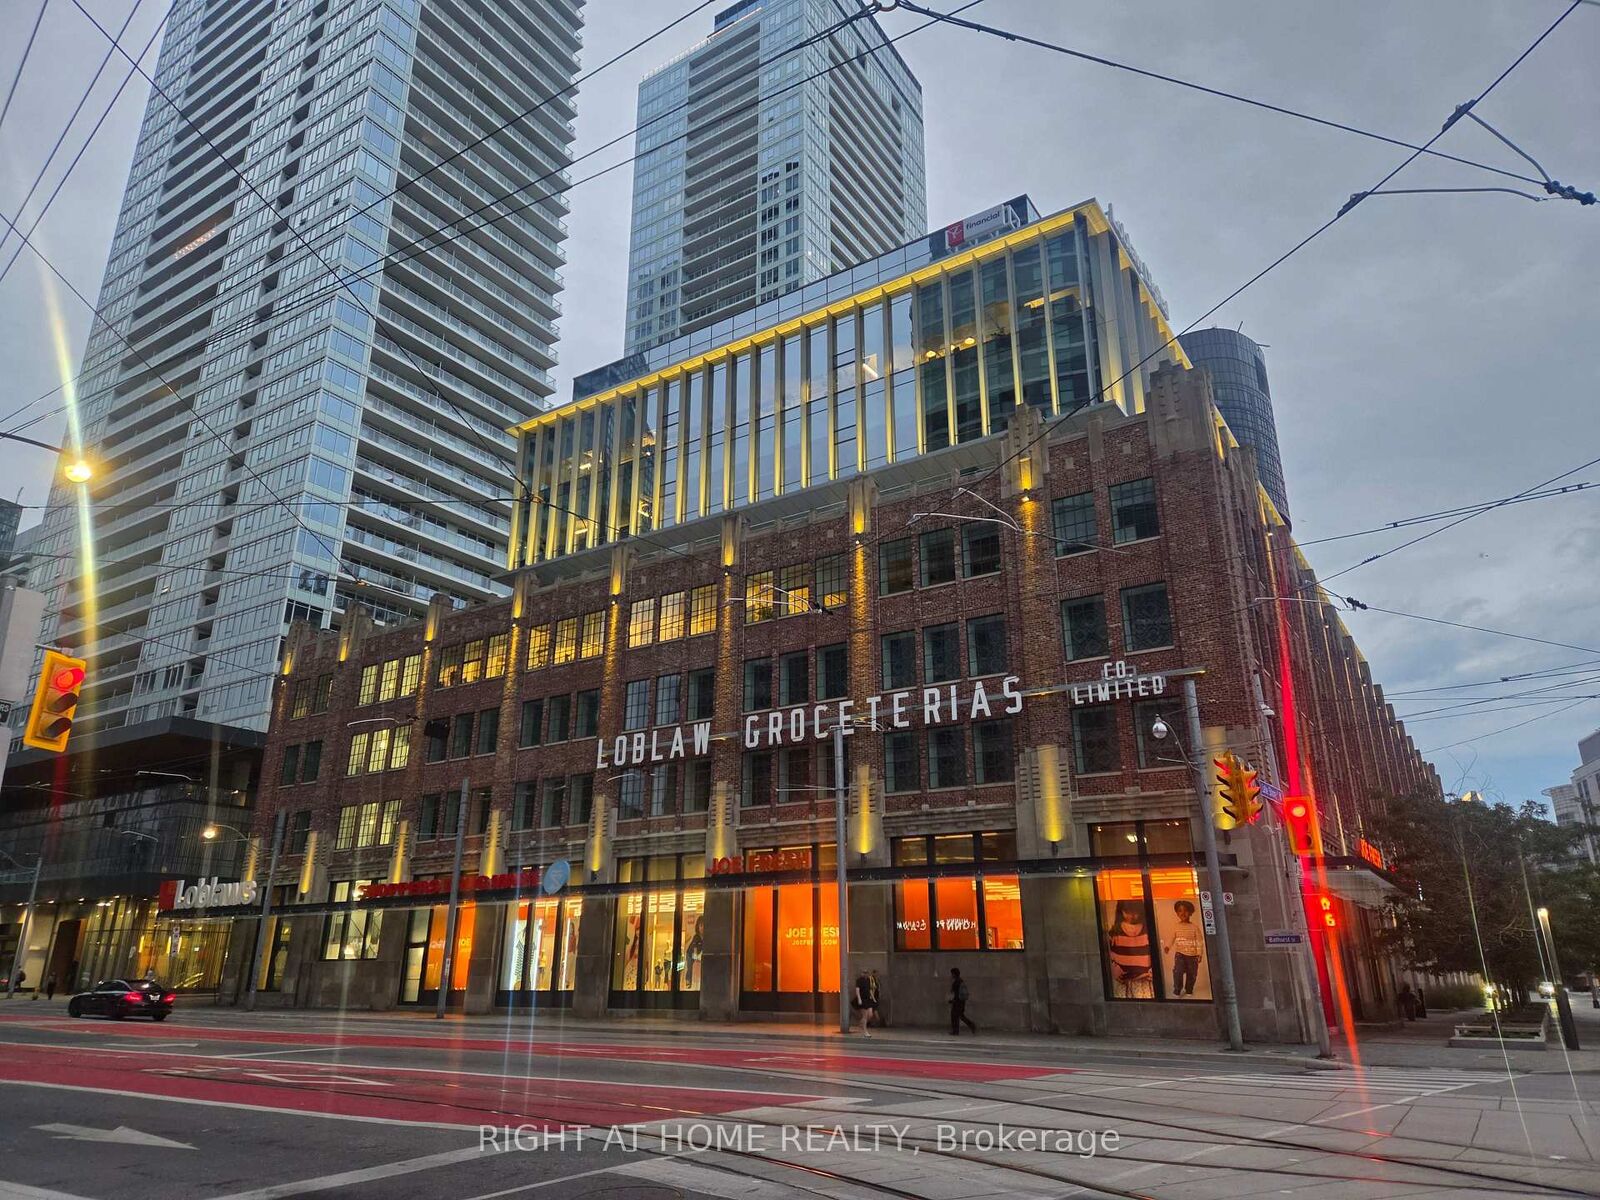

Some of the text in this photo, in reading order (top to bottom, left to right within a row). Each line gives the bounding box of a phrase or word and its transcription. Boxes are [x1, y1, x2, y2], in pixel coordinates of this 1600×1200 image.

[966, 211, 1000, 229] financial
[1073, 675, 1164, 705] LIMITED
[596, 675, 1023, 769] LOBLAW GROCETERIAS
[708, 850, 812, 874] JOE FRESH
[174, 876, 257, 909] Loblaws
[786, 927, 807, 939] JOE
